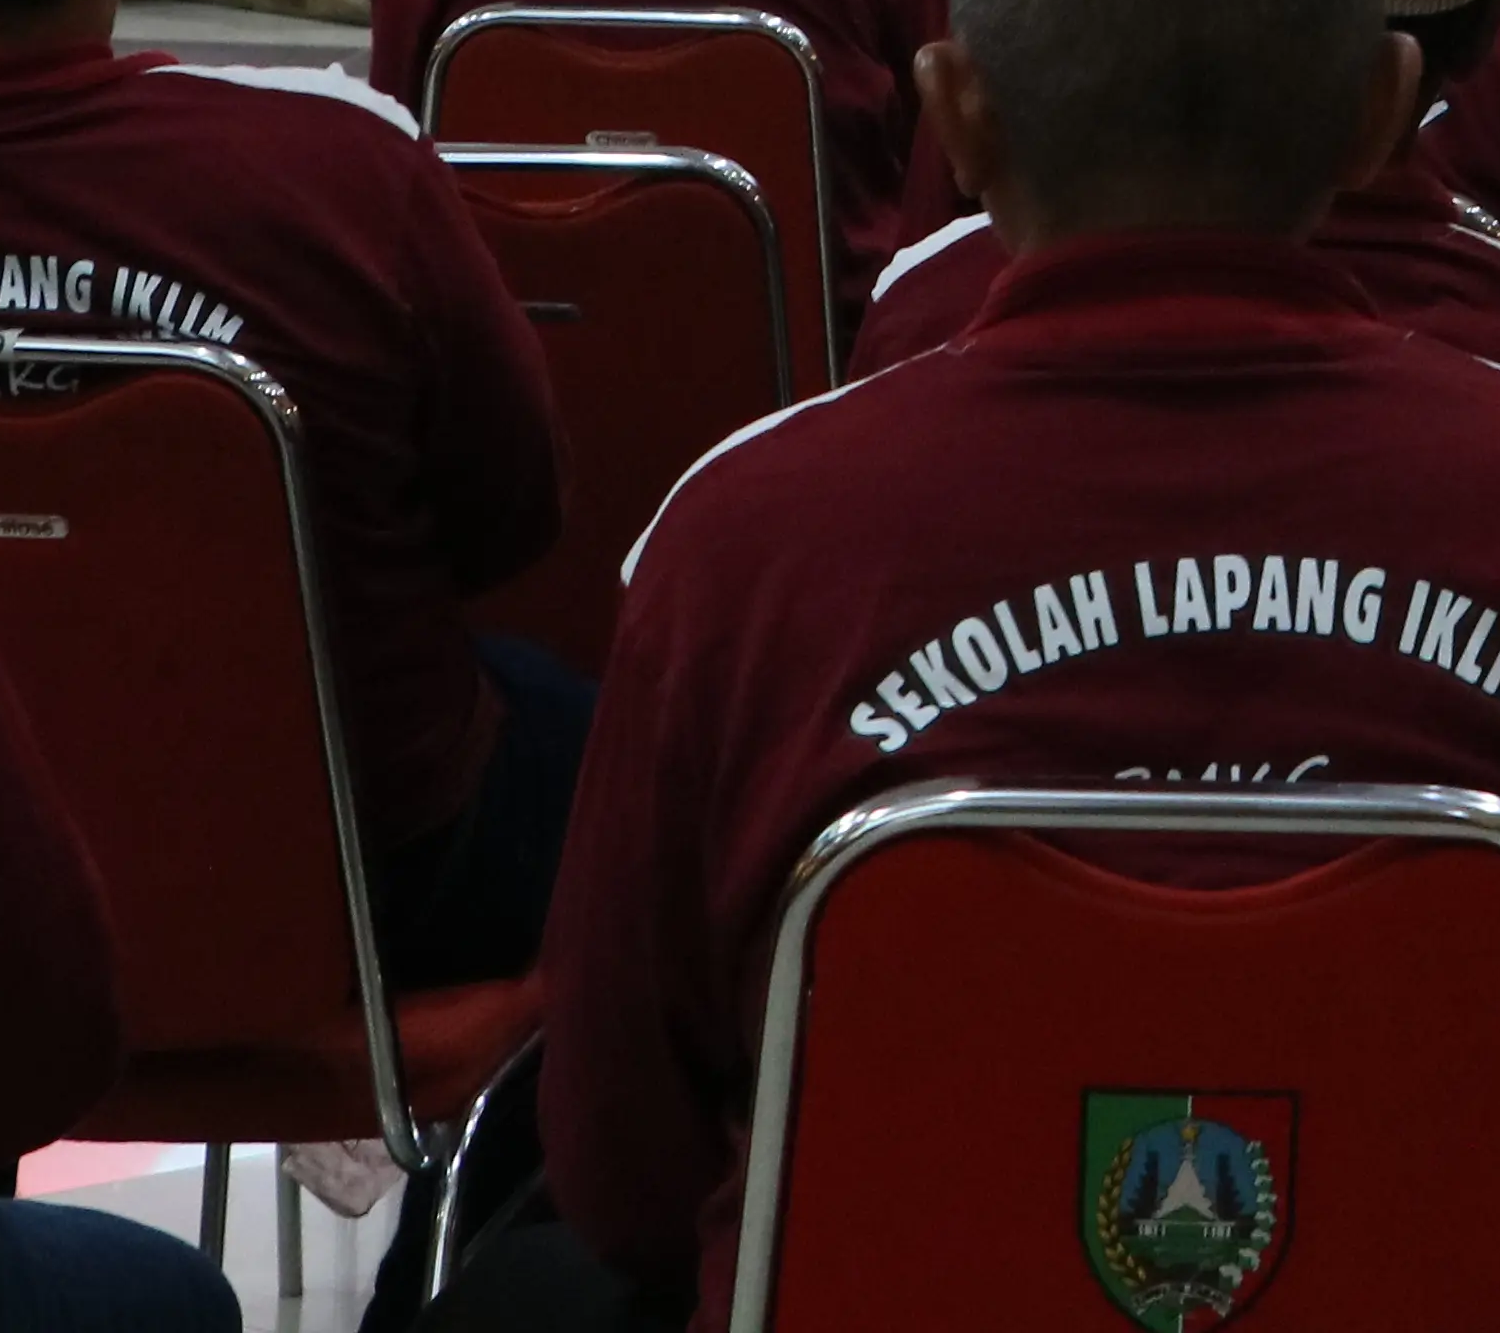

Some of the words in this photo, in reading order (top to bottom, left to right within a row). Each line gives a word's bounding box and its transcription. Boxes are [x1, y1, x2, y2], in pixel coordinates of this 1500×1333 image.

[111, 266, 244, 345] IKLIM
[850, 569, 1119, 753] SEKOLAH
[1134, 554, 1386, 644] LAPANG
